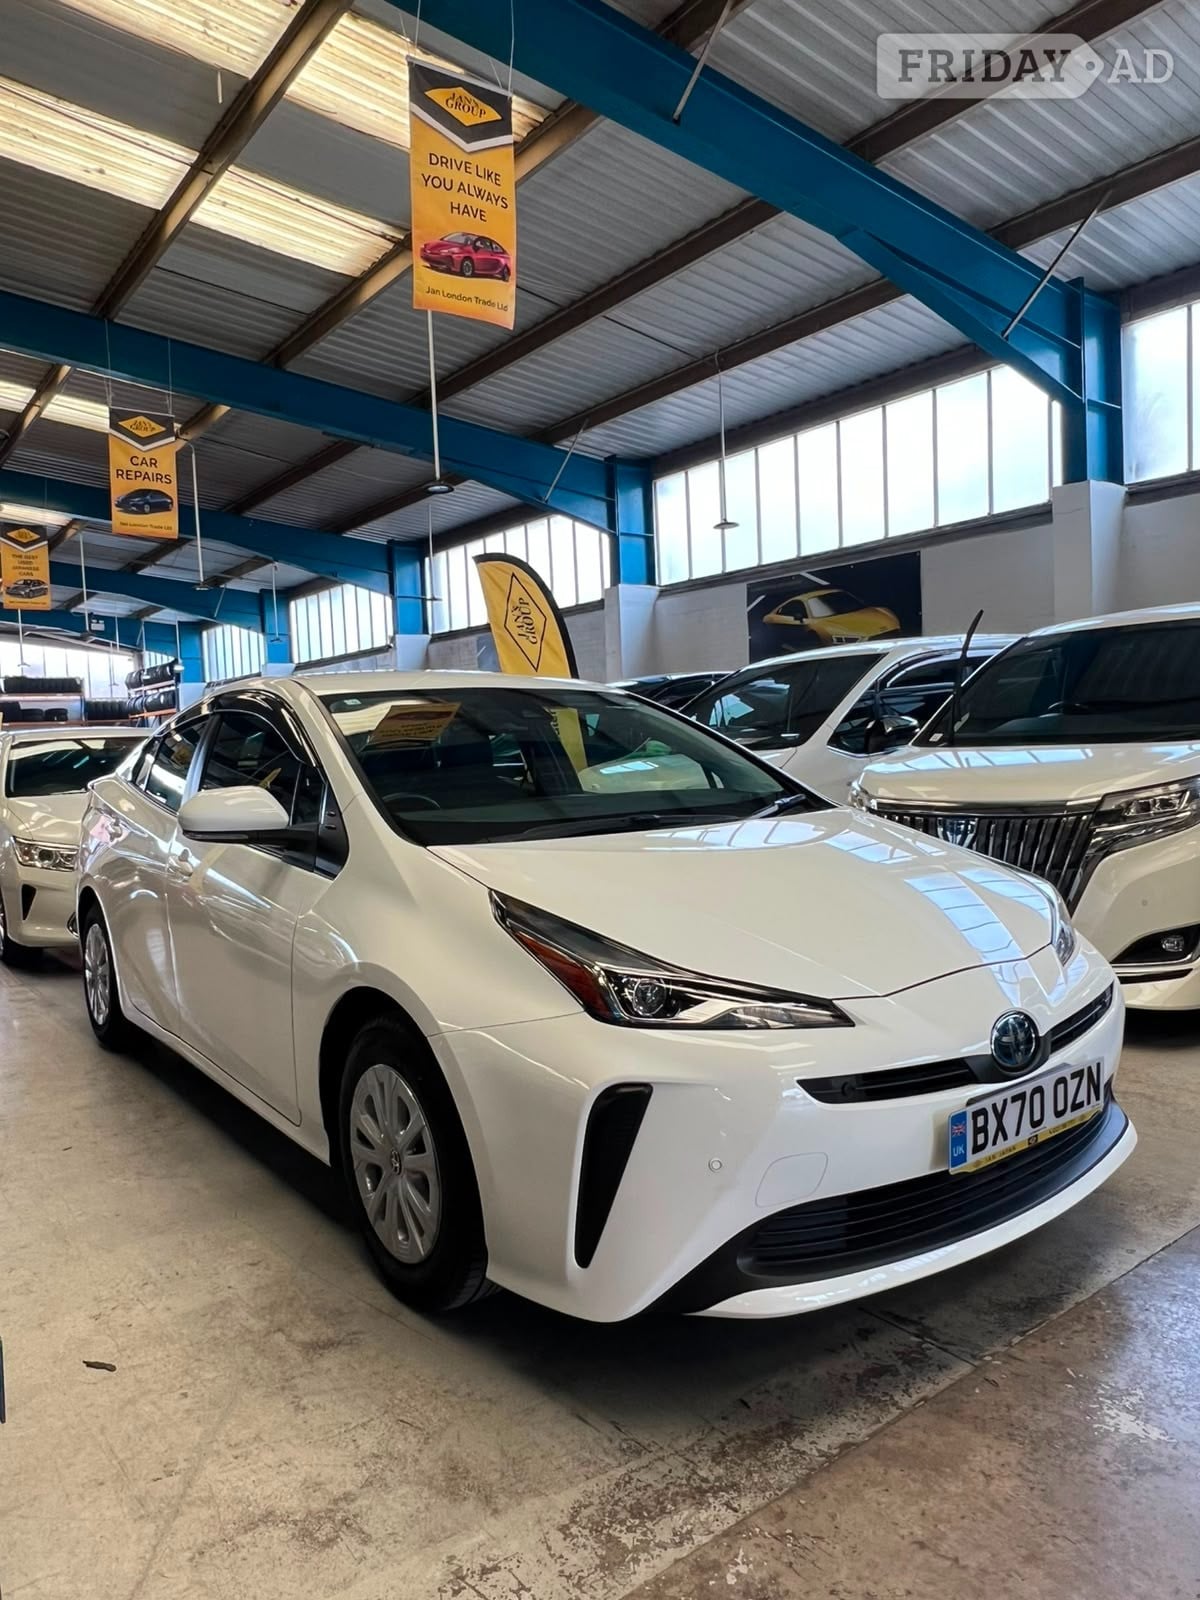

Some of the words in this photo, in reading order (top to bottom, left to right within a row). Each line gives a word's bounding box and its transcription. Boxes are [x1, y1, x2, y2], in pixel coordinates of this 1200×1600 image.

[445, 97, 486, 118] GROUP
[429, 152, 472, 174] DRIVE
[476, 164, 501, 187] LIKE
[421, 173, 453, 191] YOU
[457, 181, 508, 209] ALWAYS
[450, 201, 487, 222] HAVE
[425, 286, 440, 296] Jan
[442, 290, 473, 303] London
[474, 296, 495, 308] Trade
[130, 455, 158, 468] CAR
[115, 468, 172, 485] REPAIRS
[518, 597, 538, 645] GROUP
[971, 1085, 1045, 1155] BX70
[1053, 1062, 1101, 1119] OZN
[953, 1144, 965, 1157] UK
